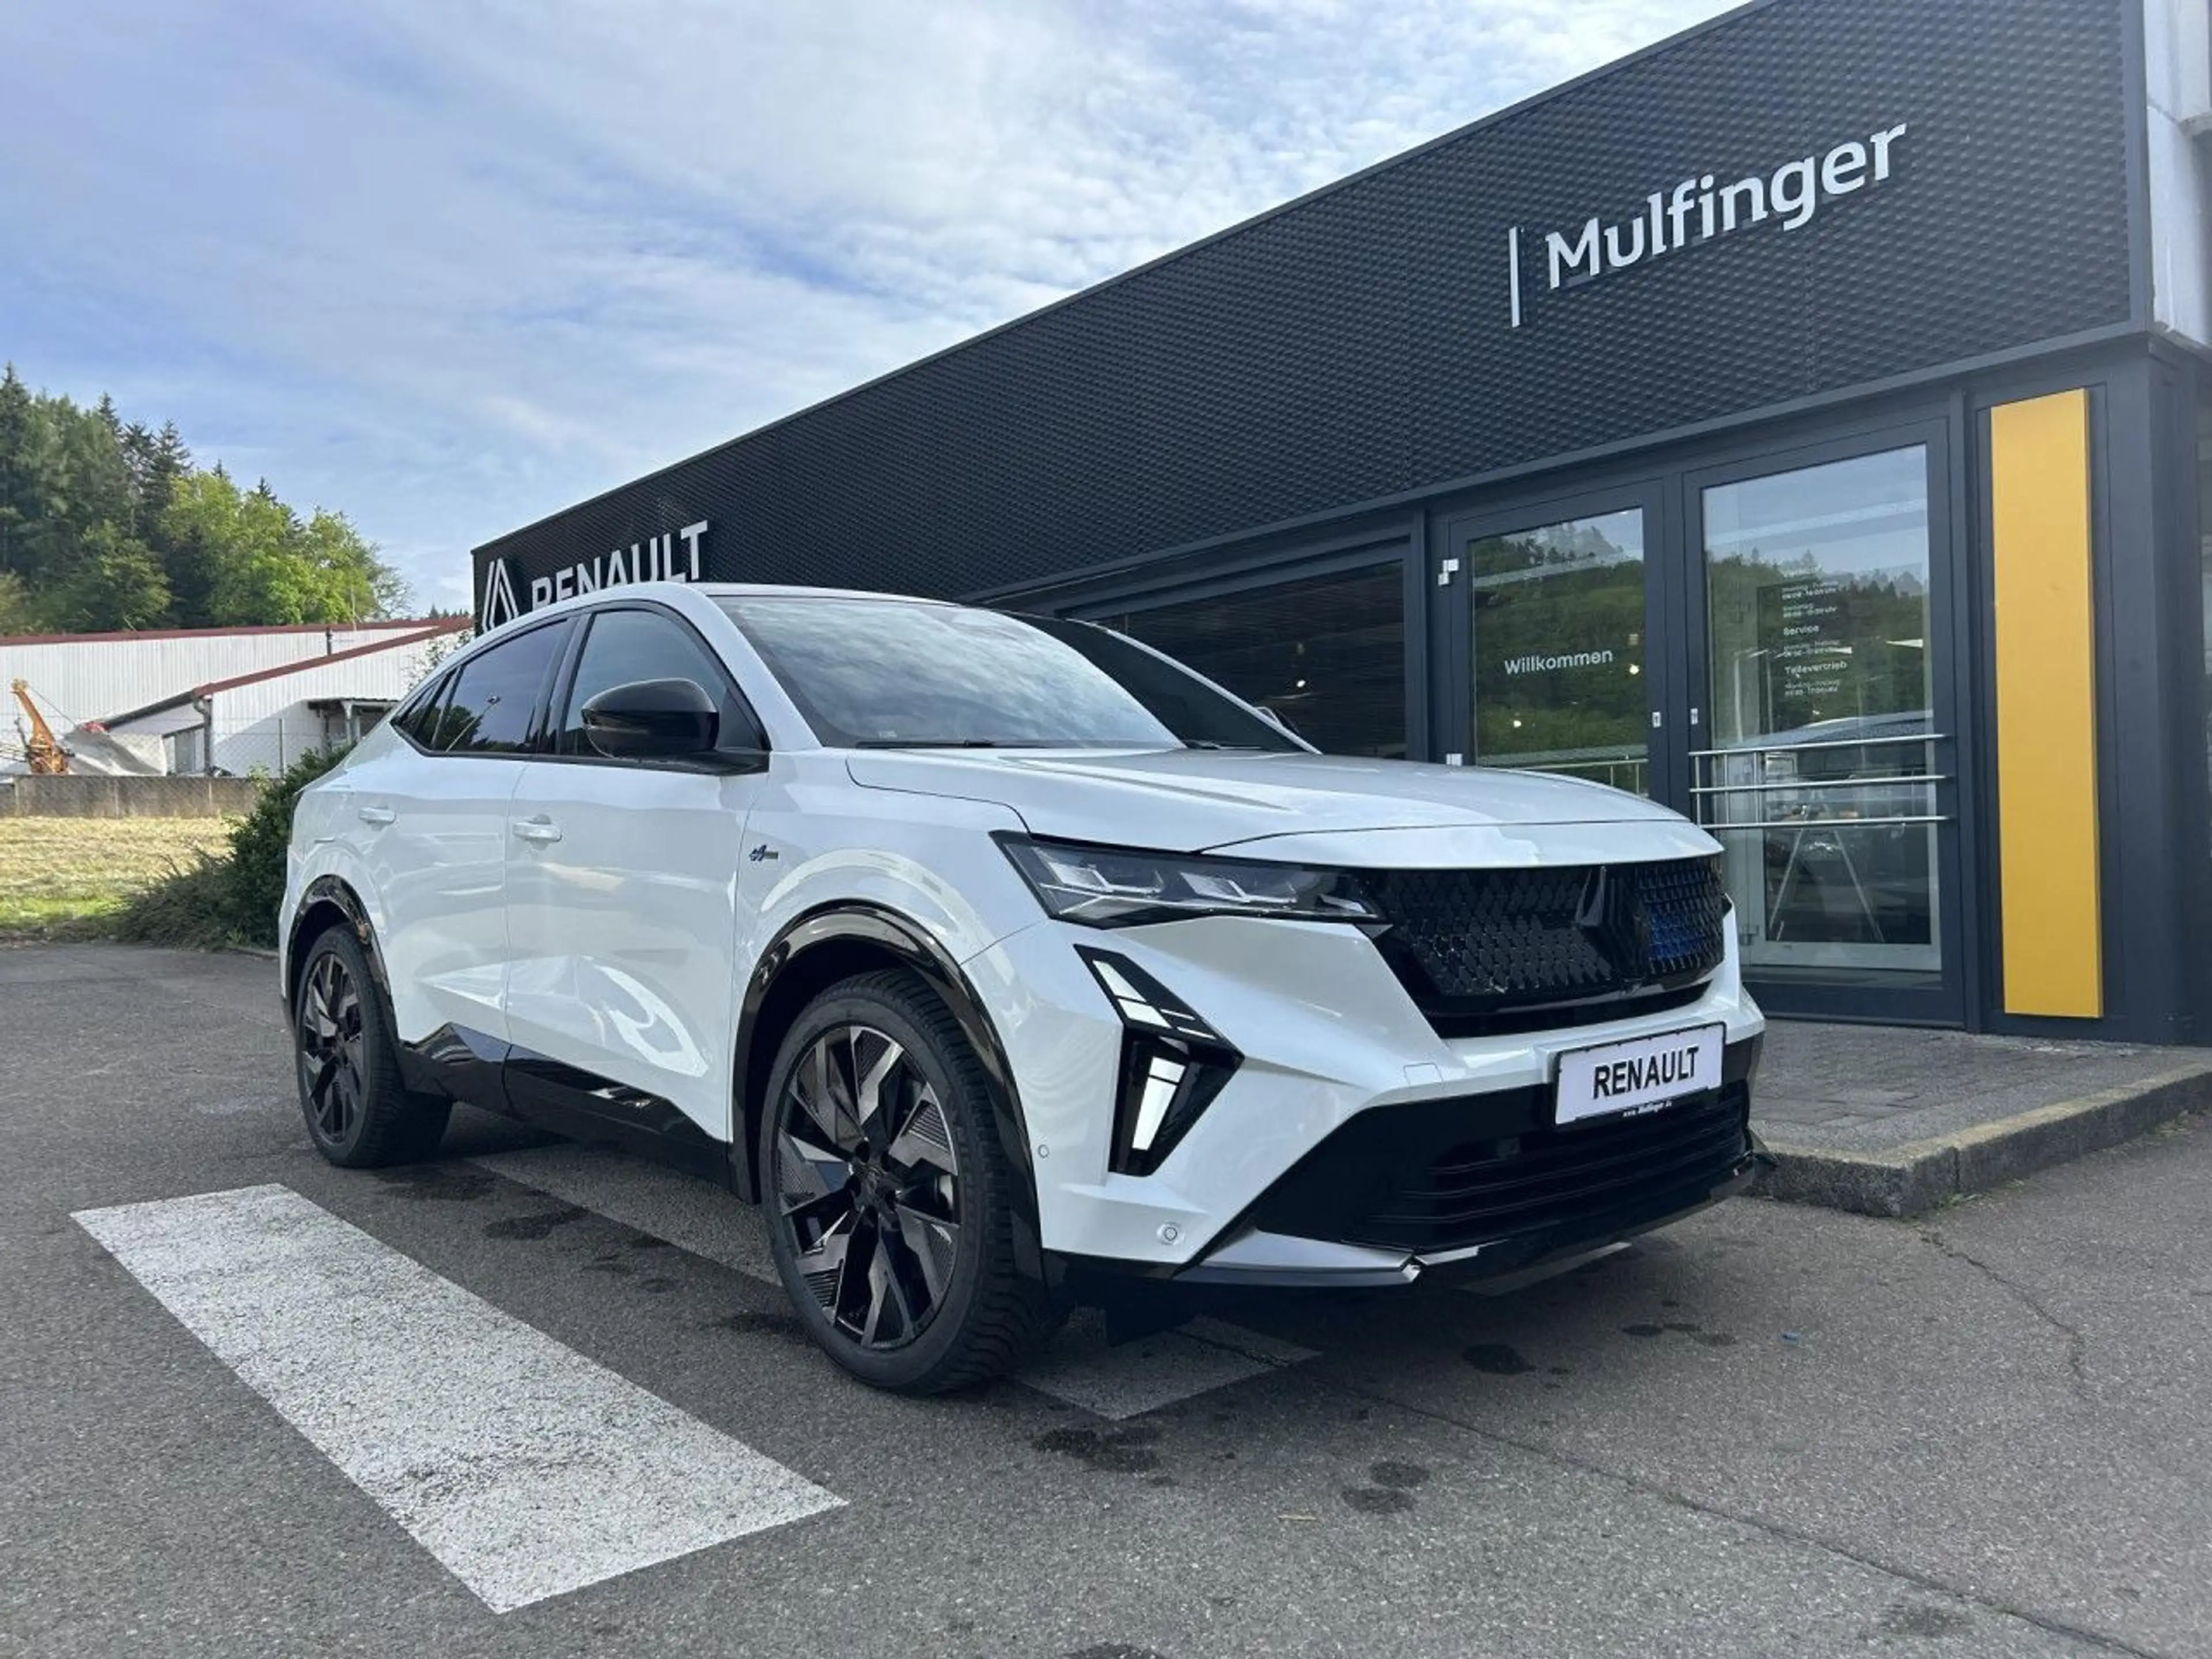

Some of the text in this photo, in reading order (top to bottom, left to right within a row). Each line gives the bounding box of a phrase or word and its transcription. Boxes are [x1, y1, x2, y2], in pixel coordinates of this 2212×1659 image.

[1545, 123, 1907, 289] Mulfinger
[1504, 649, 1613, 675] Willkommen
[1593, 1046, 1699, 1100] RENAULT
